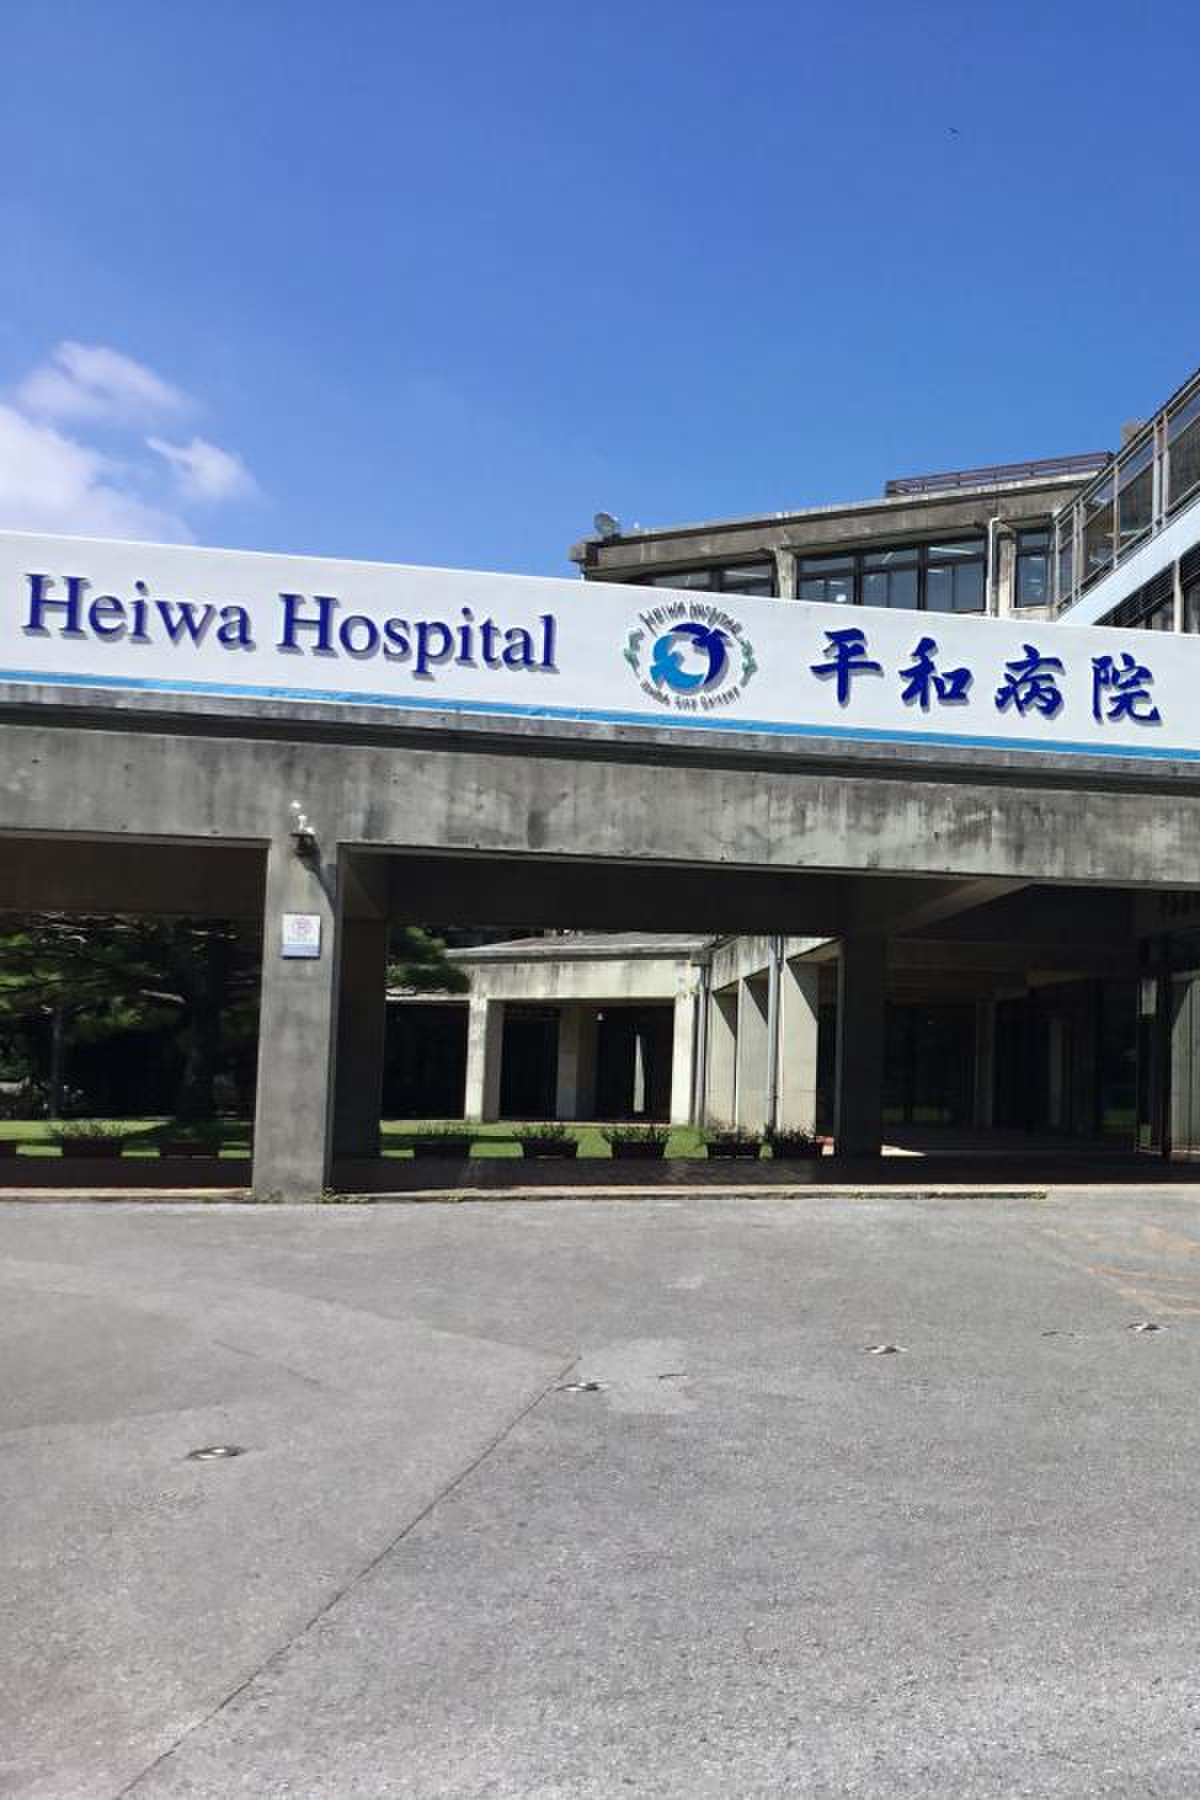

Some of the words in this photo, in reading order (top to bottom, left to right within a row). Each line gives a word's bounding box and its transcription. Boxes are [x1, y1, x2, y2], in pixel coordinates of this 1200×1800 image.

[22, 573, 253, 647] Heiwa
[276, 592, 558, 675] Hospital
[810, 627, 1161, 724] 平和病院
